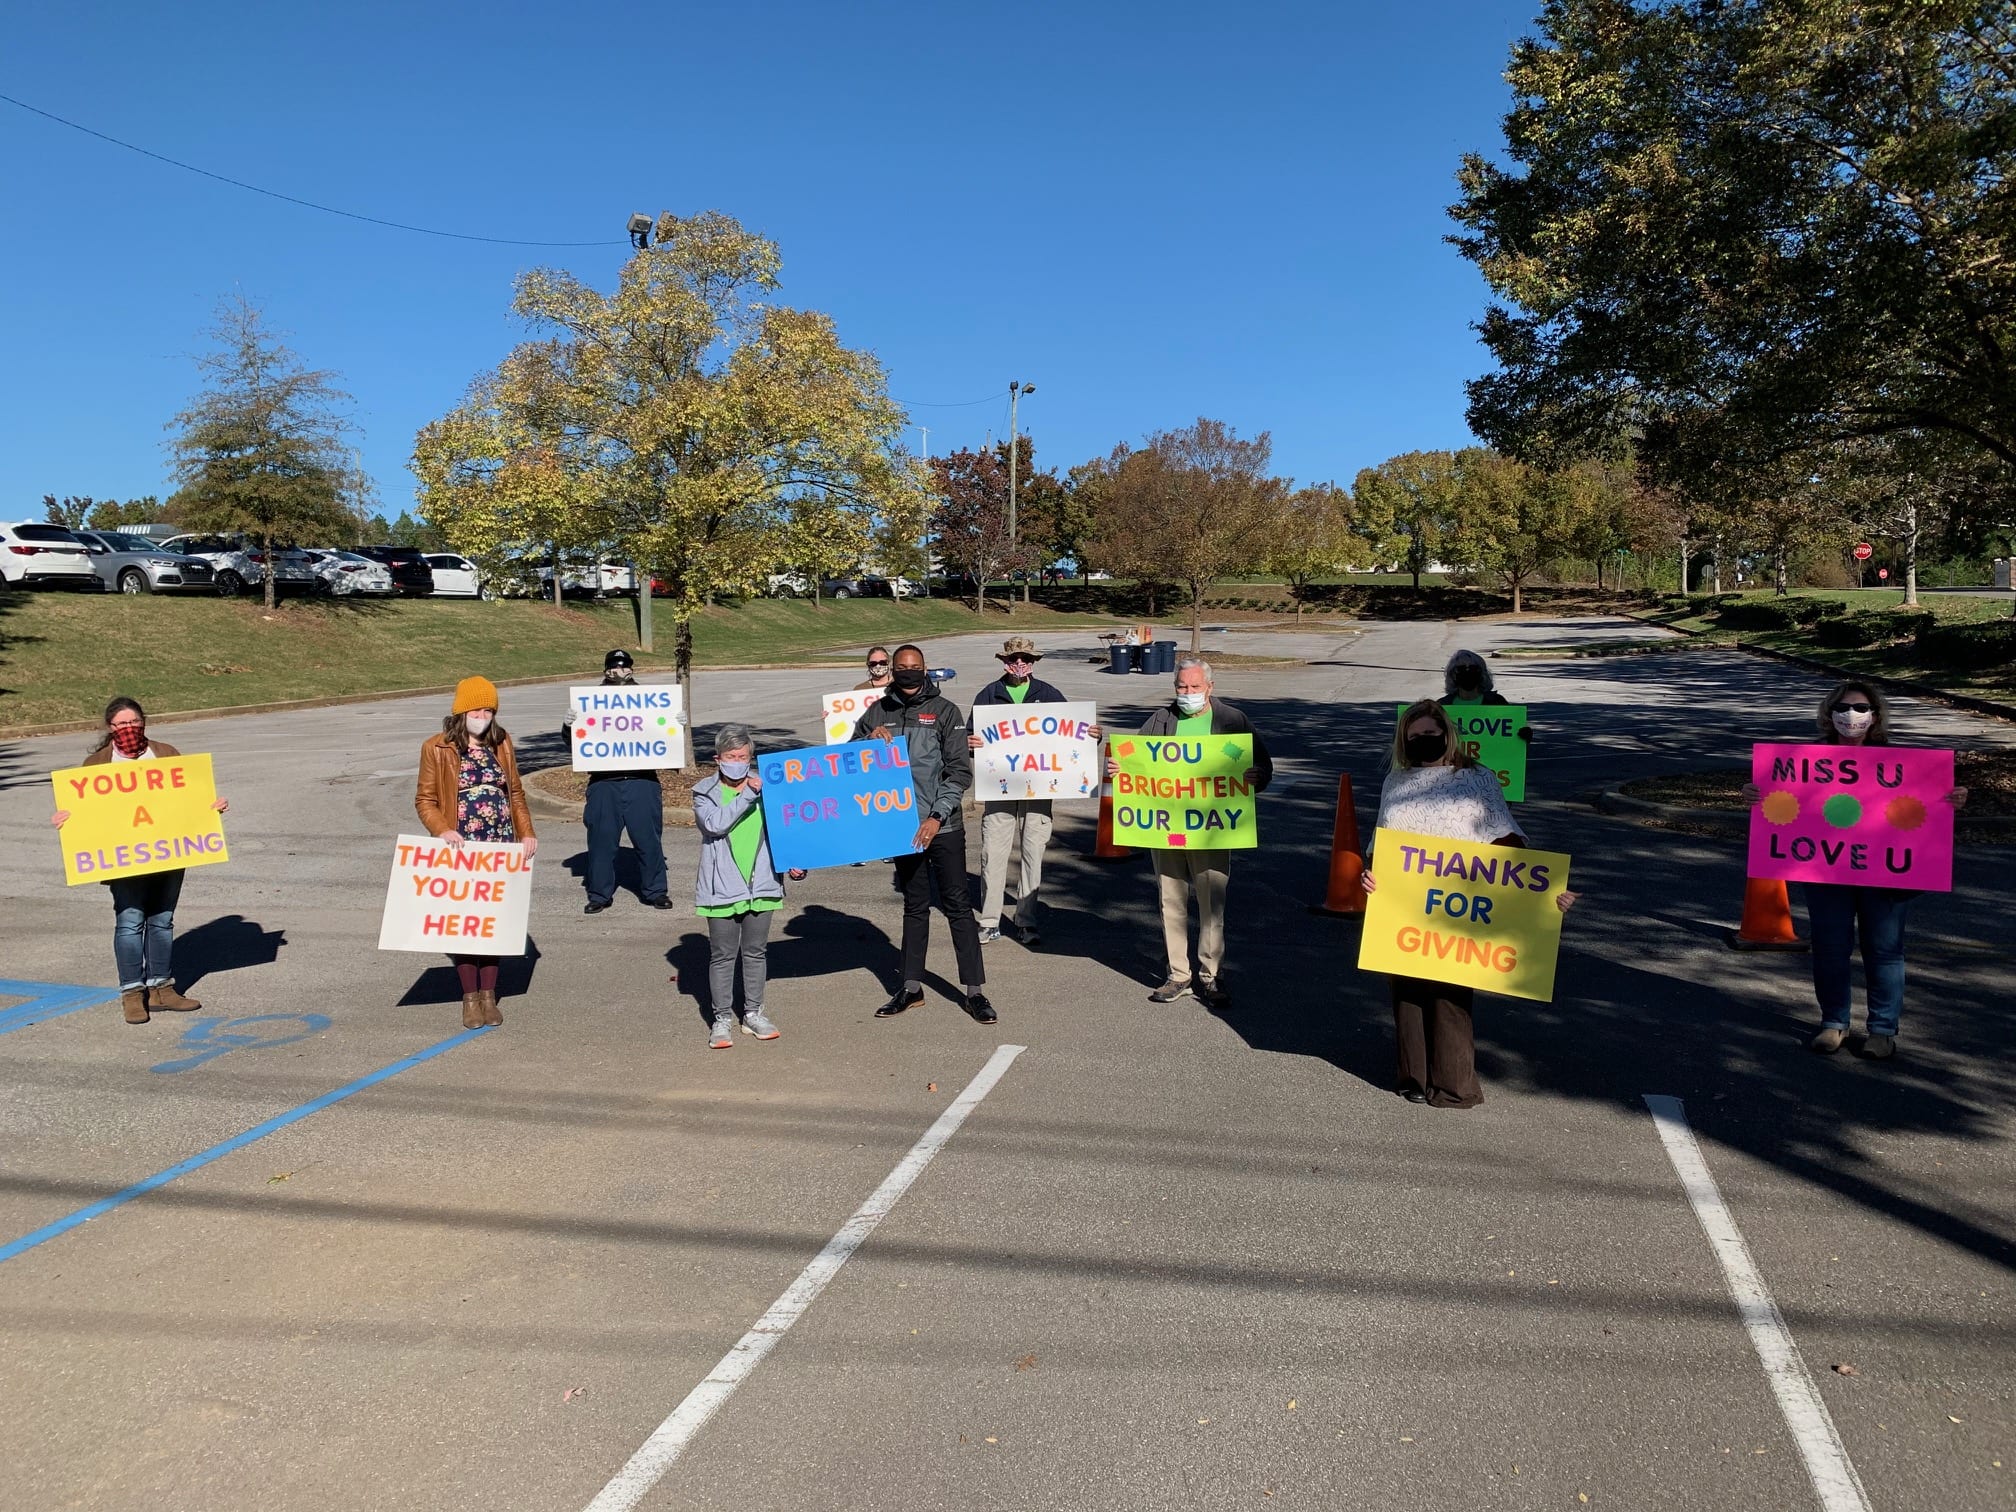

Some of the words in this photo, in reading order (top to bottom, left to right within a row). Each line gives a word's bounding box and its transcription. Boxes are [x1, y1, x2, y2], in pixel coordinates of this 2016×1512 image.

[578, 692, 671, 713] THANKS
[832, 698, 855, 713] SO
[602, 716, 643, 732] FOR
[982, 716, 1089, 744] WELCOME
[1457, 718, 1513, 737] LOVE
[580, 740, 667, 758] COMING
[1146, 741, 1202, 764] YOU
[764, 746, 910, 785] GRATEFUL
[1771, 757, 1860, 785] MISS
[1876, 762, 1904, 788] U
[70, 767, 186, 799] YOU'RE
[1118, 772, 1250, 799] BRIGHTEN
[132, 805, 154, 828] A
[782, 797, 840, 828] FOR
[853, 787, 913, 816] YOU
[1117, 806, 1170, 831] OUR
[1185, 808, 1243, 831] DAY
[75, 832, 223, 874] BLESSING
[398, 845, 531, 873] THANKFUL
[1770, 833, 1868, 870] LOVE
[1885, 847, 1913, 874] U
[1400, 845, 1550, 892] THANKS
[412, 874, 506, 902] YOU'RE
[1425, 888, 1494, 925] FOR
[423, 914, 496, 938] HERE
[1396, 926, 1518, 973] GIVING
